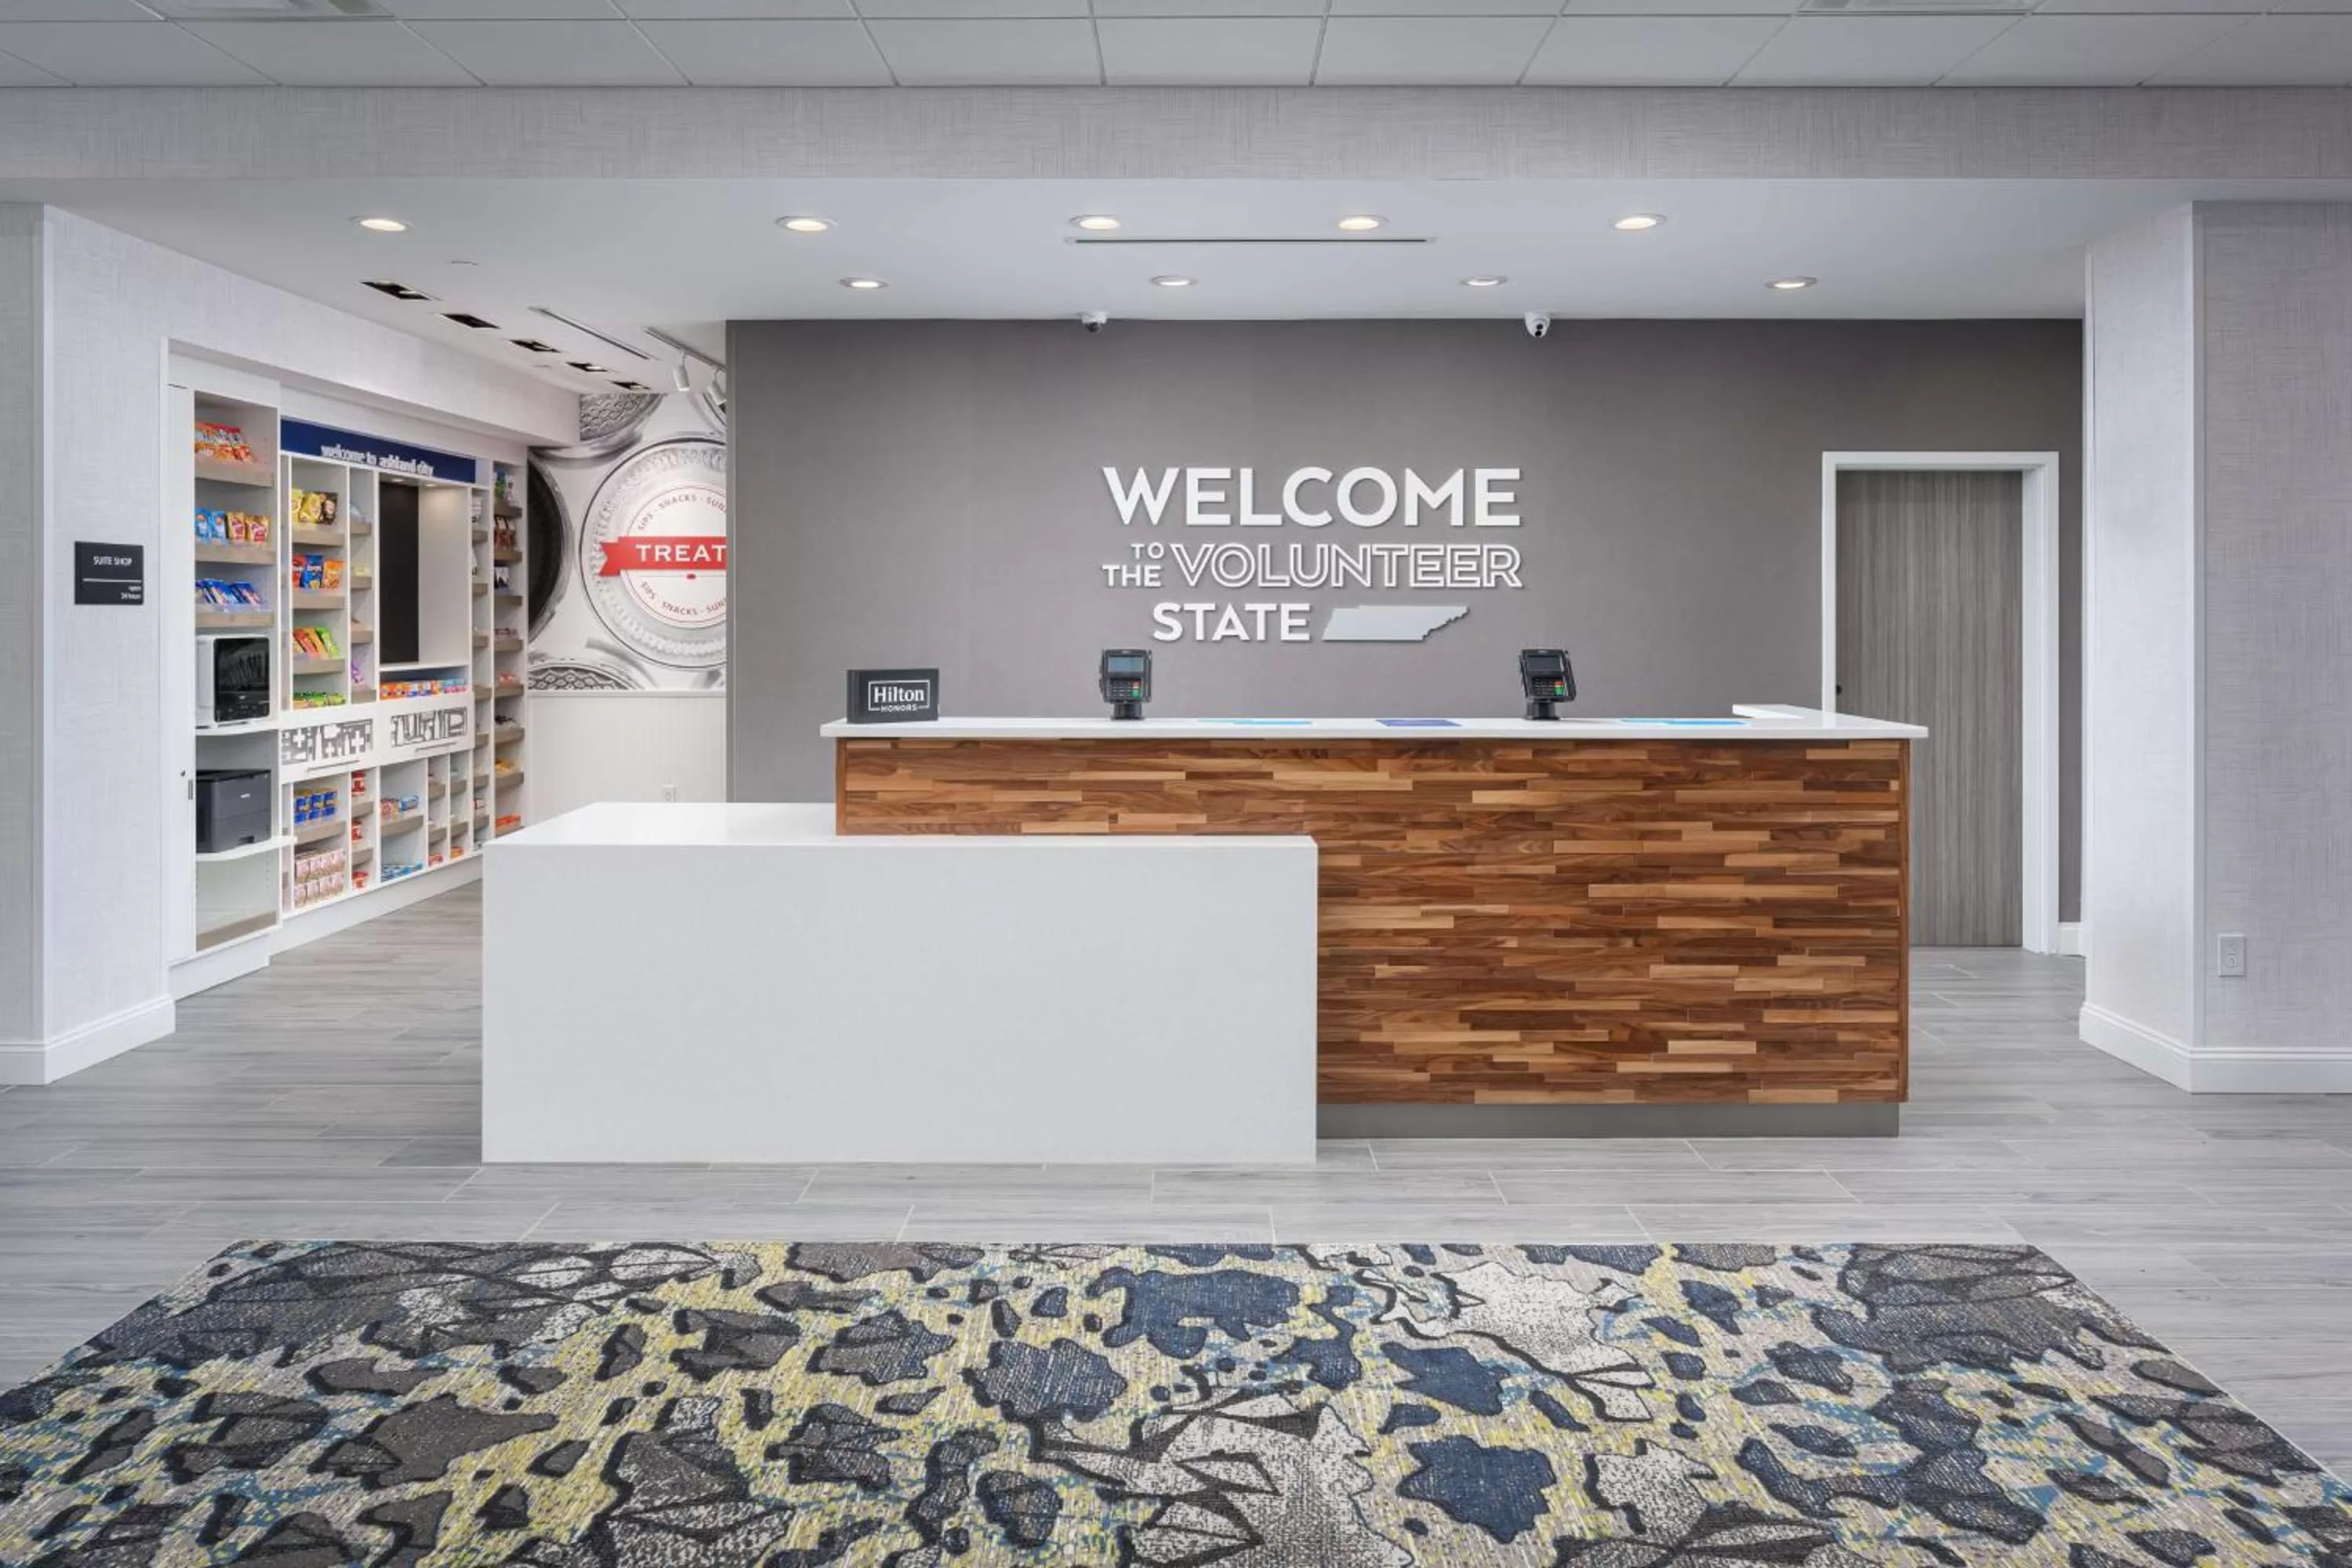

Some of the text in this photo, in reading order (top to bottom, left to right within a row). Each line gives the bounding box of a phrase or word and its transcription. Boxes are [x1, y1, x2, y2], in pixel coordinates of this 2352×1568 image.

[321, 444, 434, 477] welcome to ashland city
[659, 494, 697, 509] SNACKS
[1102, 466, 1521, 527] WELCOME
[635, 544, 727, 562] TREAT
[1131, 542, 1164, 559] TO
[114, 557, 132, 566] SHOP
[1102, 543, 1523, 588] THE VOLUNTEER
[662, 601, 698, 615] SNACKS
[1152, 602, 1311, 642] STATE
[873, 686, 925, 703] Hilton
[880, 704, 918, 713] HONORS
